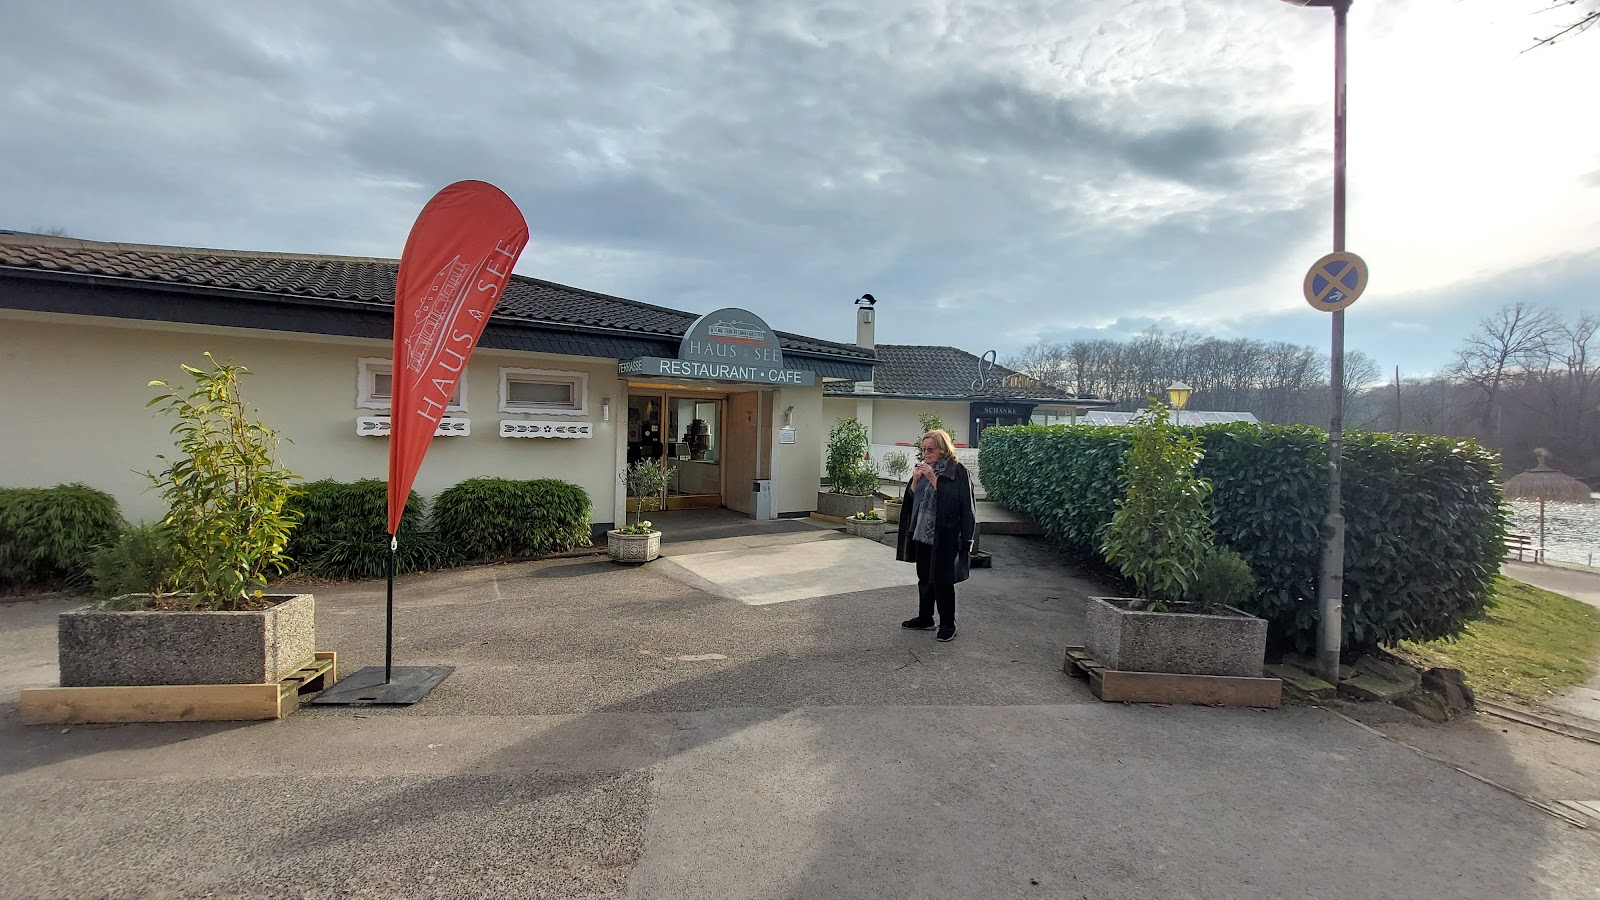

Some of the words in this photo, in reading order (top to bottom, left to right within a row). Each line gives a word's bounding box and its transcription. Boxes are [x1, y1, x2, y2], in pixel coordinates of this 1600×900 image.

[417, 328, 474, 422] HAUS
[477, 240, 518, 298] SEE
[690, 340, 736, 358] HAUS
[754, 347, 780, 362] SEE
[618, 360, 642, 373] TERRASSE
[660, 359, 757, 380] RESTAURANT
[768, 369, 801, 384] CAFE
